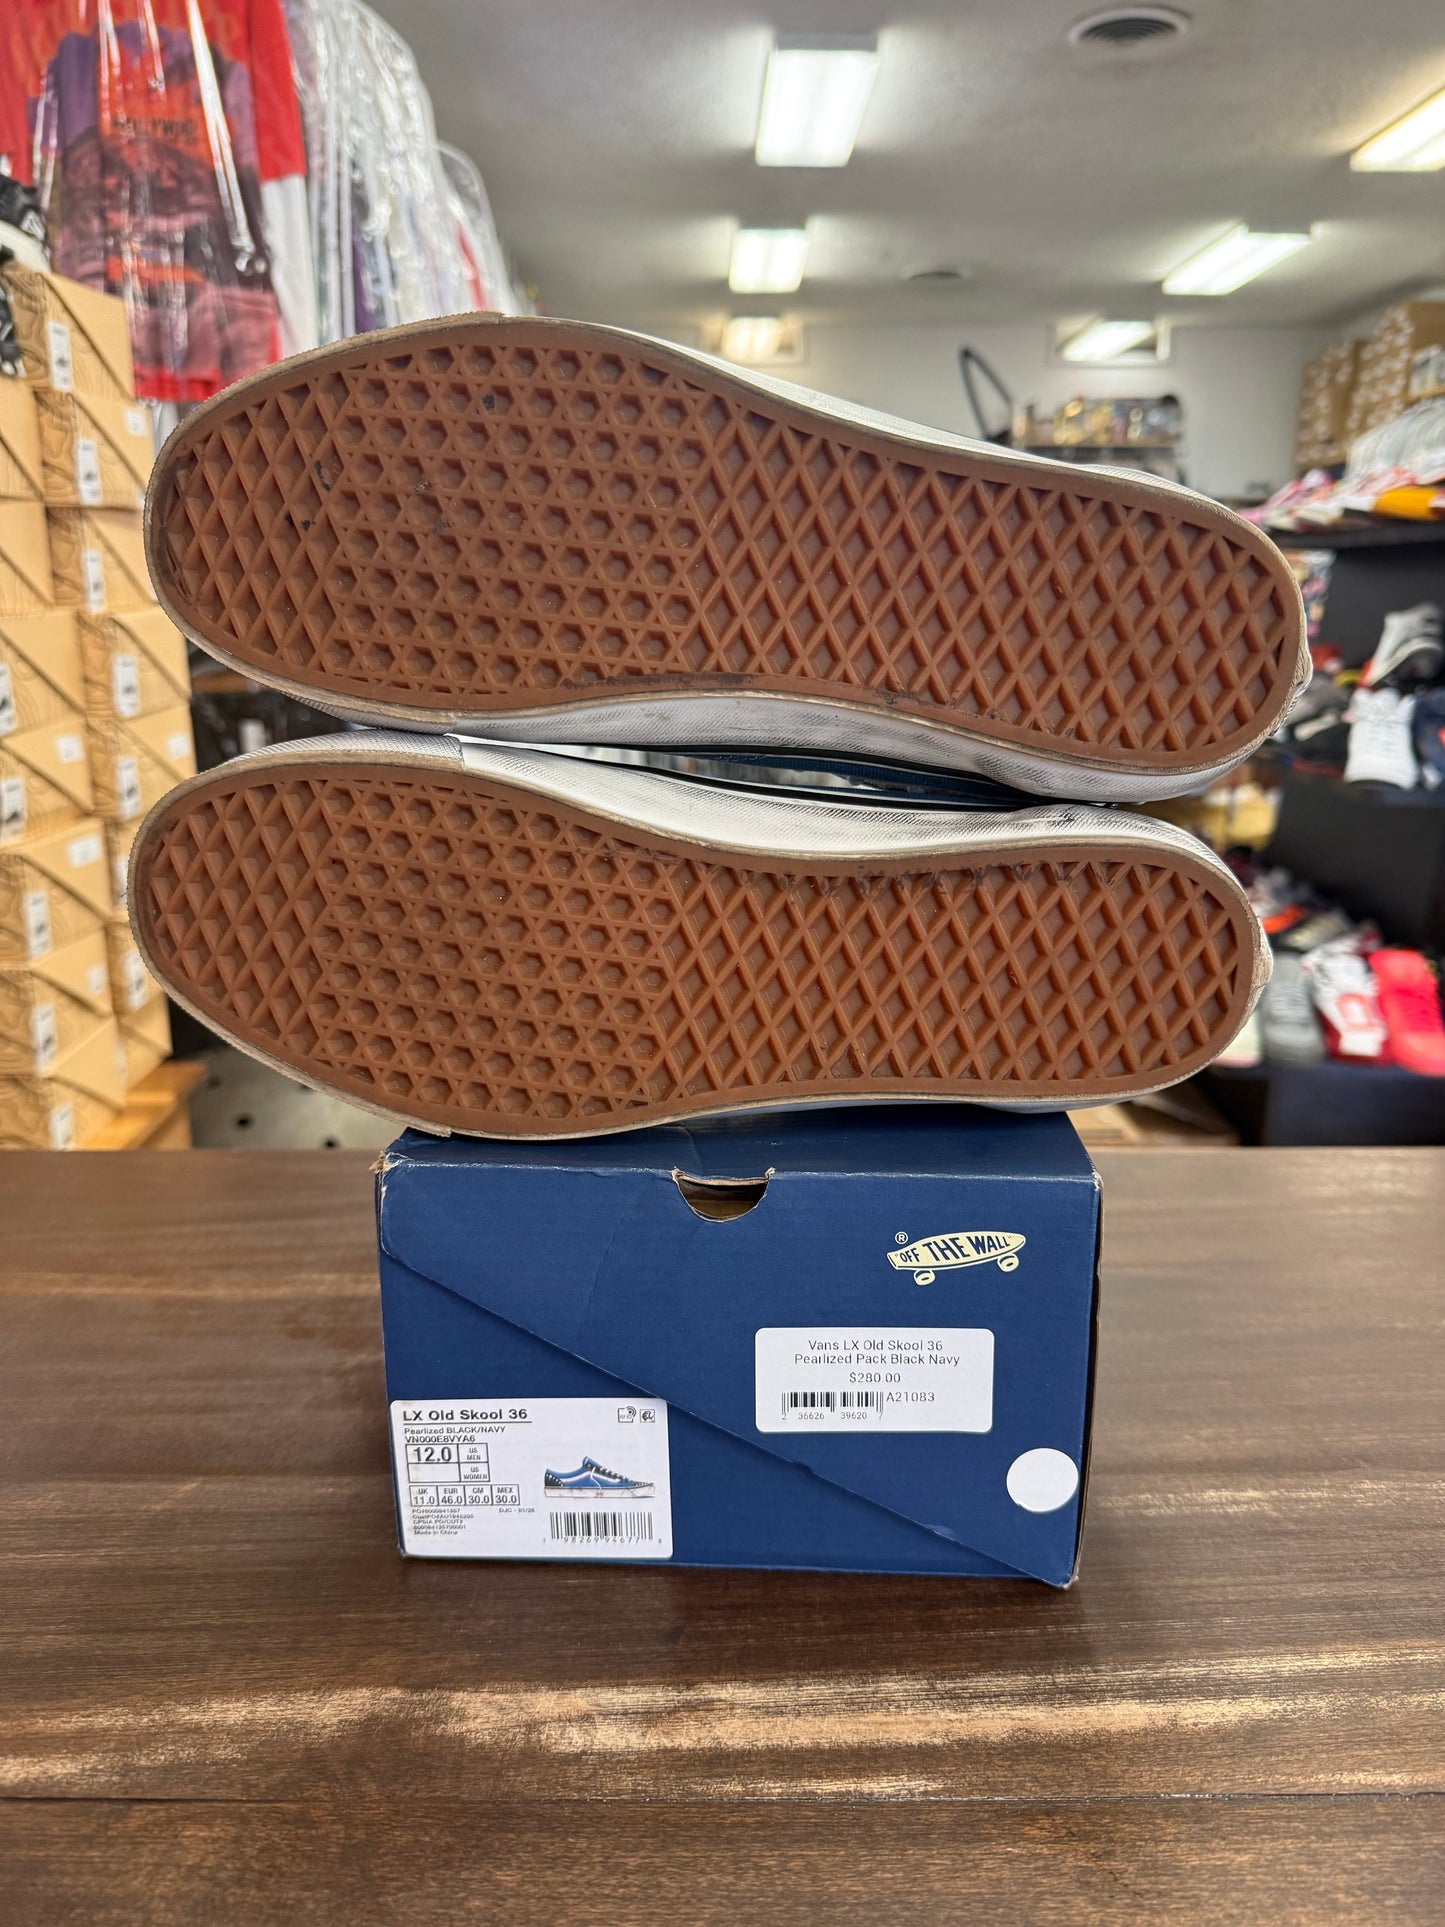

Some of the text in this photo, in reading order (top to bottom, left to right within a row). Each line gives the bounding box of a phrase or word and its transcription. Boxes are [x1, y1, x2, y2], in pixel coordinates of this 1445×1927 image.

[922, 1237, 970, 1262] THE
[808, 1339, 942, 1350] Vans LX Old Skool 36
[794, 1353, 960, 1366] Pearlized Pack Black Navy
[849, 1372, 900, 1384] $280.00
[886, 1392, 934, 1402] A21083
[403, 1408, 528, 1421] LX Old Skool 36
[782, 1411, 884, 1420] 2 36626 39620 7
[405, 1435, 476, 1443] VN000E8VYA6
[414, 1446, 452, 1462] 12.0
[414, 1495, 517, 1504] 11.0 46.0 30.0 30.0
